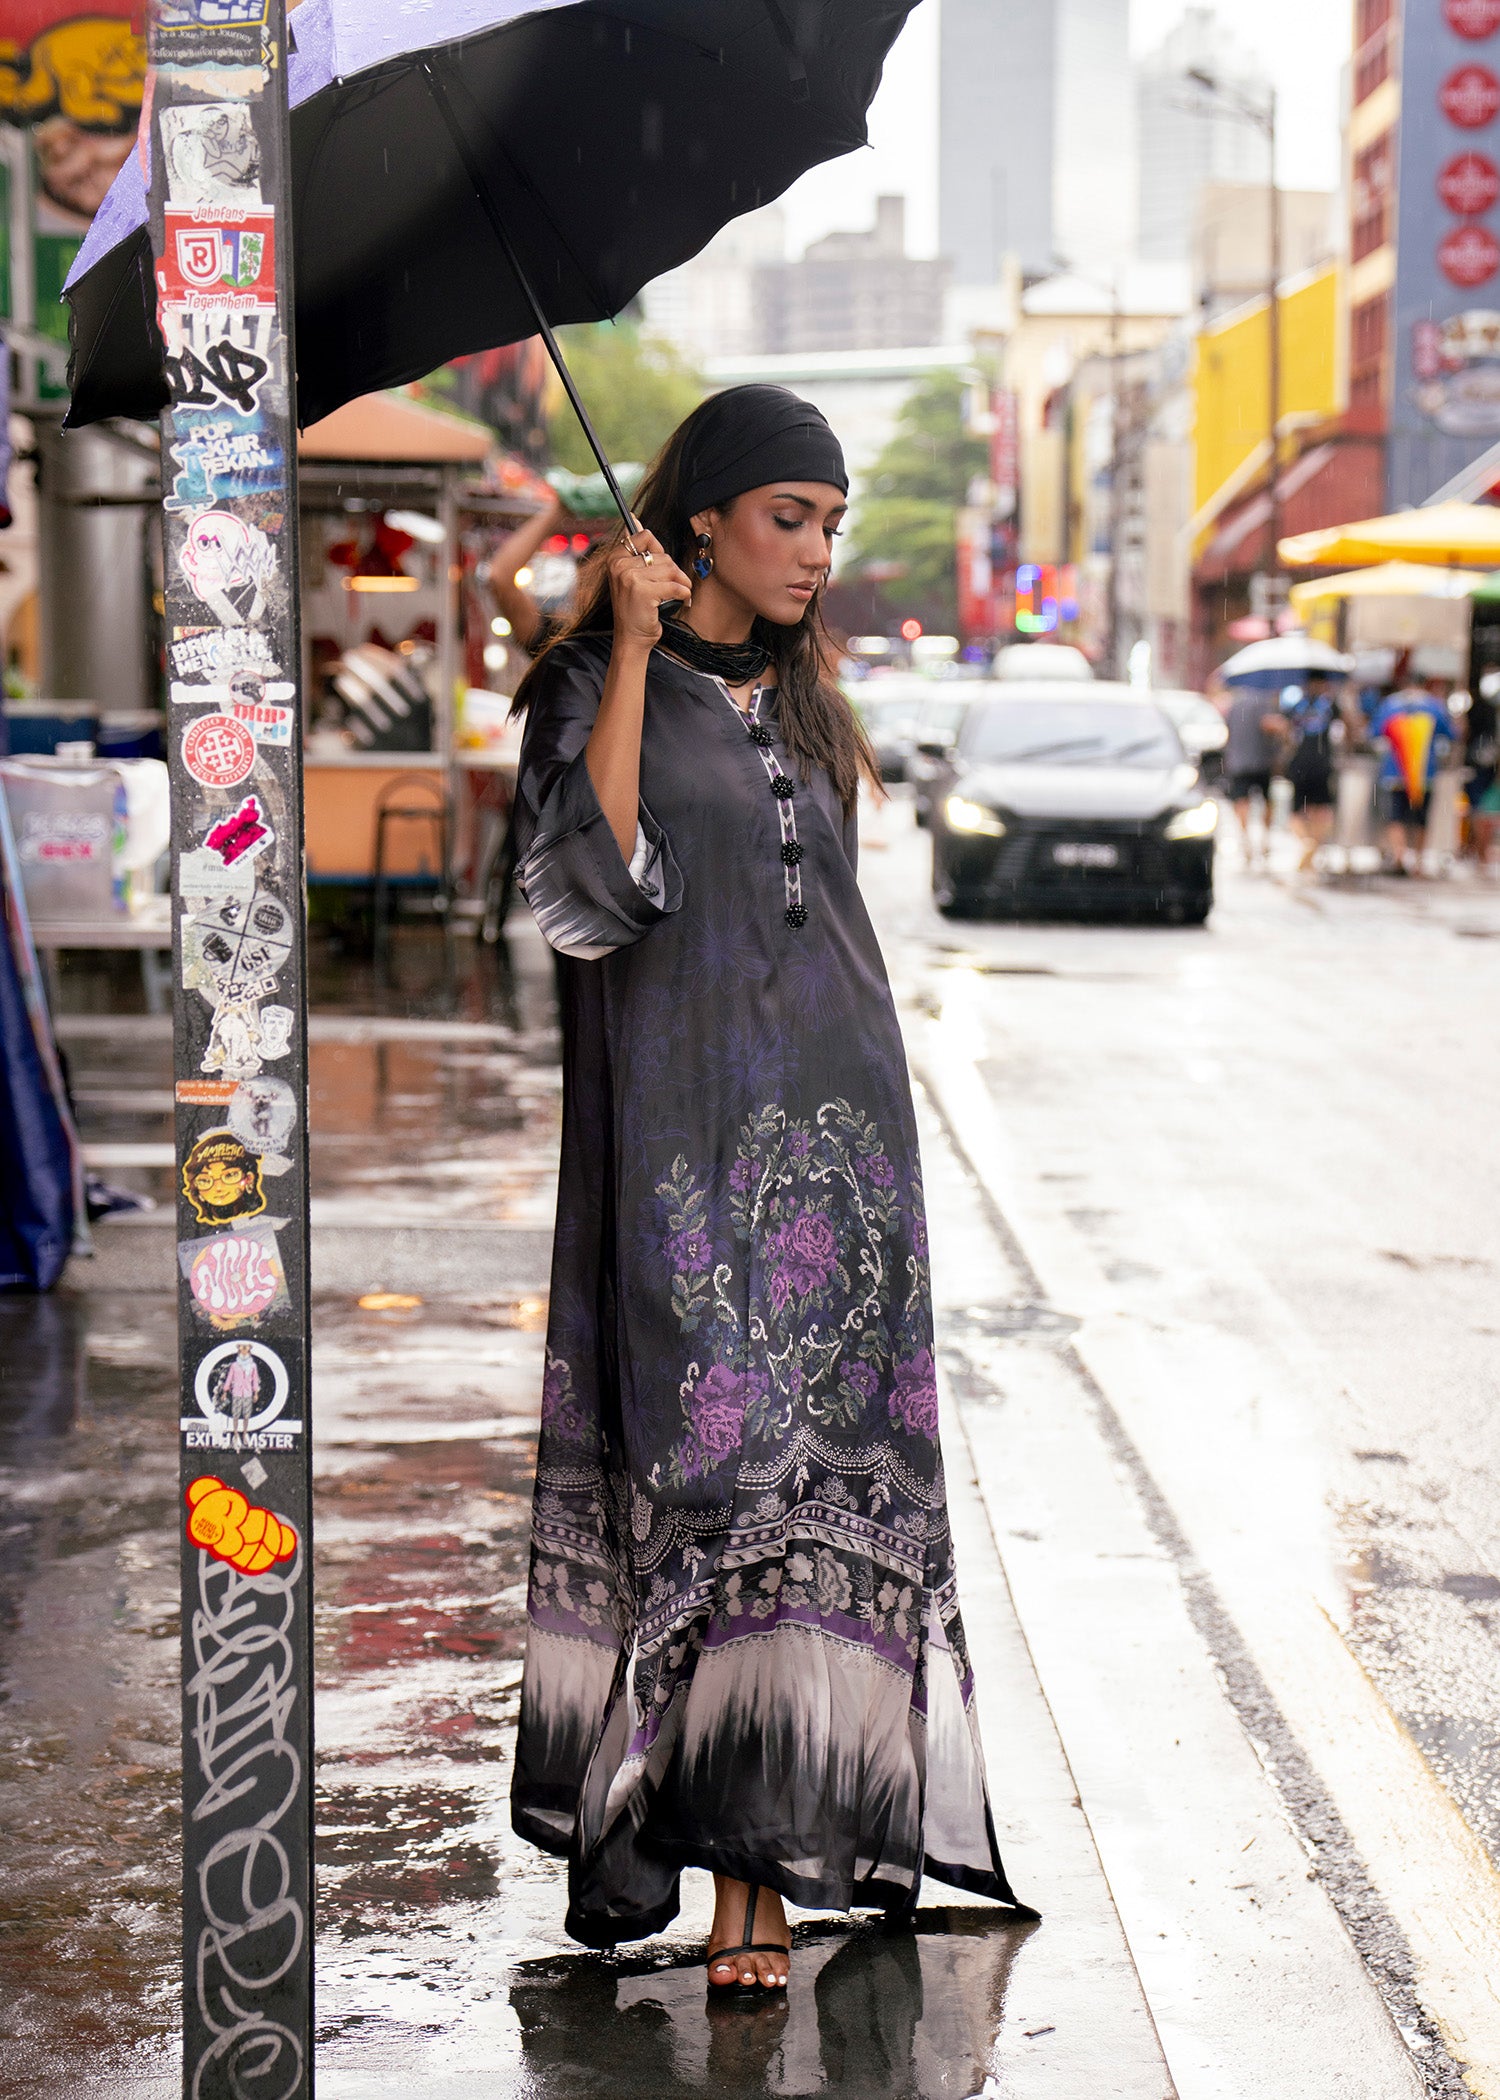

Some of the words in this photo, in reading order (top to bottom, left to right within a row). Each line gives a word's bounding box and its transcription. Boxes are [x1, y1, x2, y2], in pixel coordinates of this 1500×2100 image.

[194, 206, 245, 221] Jahnfans
[186, 293, 256, 312] Tegernheim
[190, 421, 232, 440] POP
[186, 717, 220, 755] CODIGO
